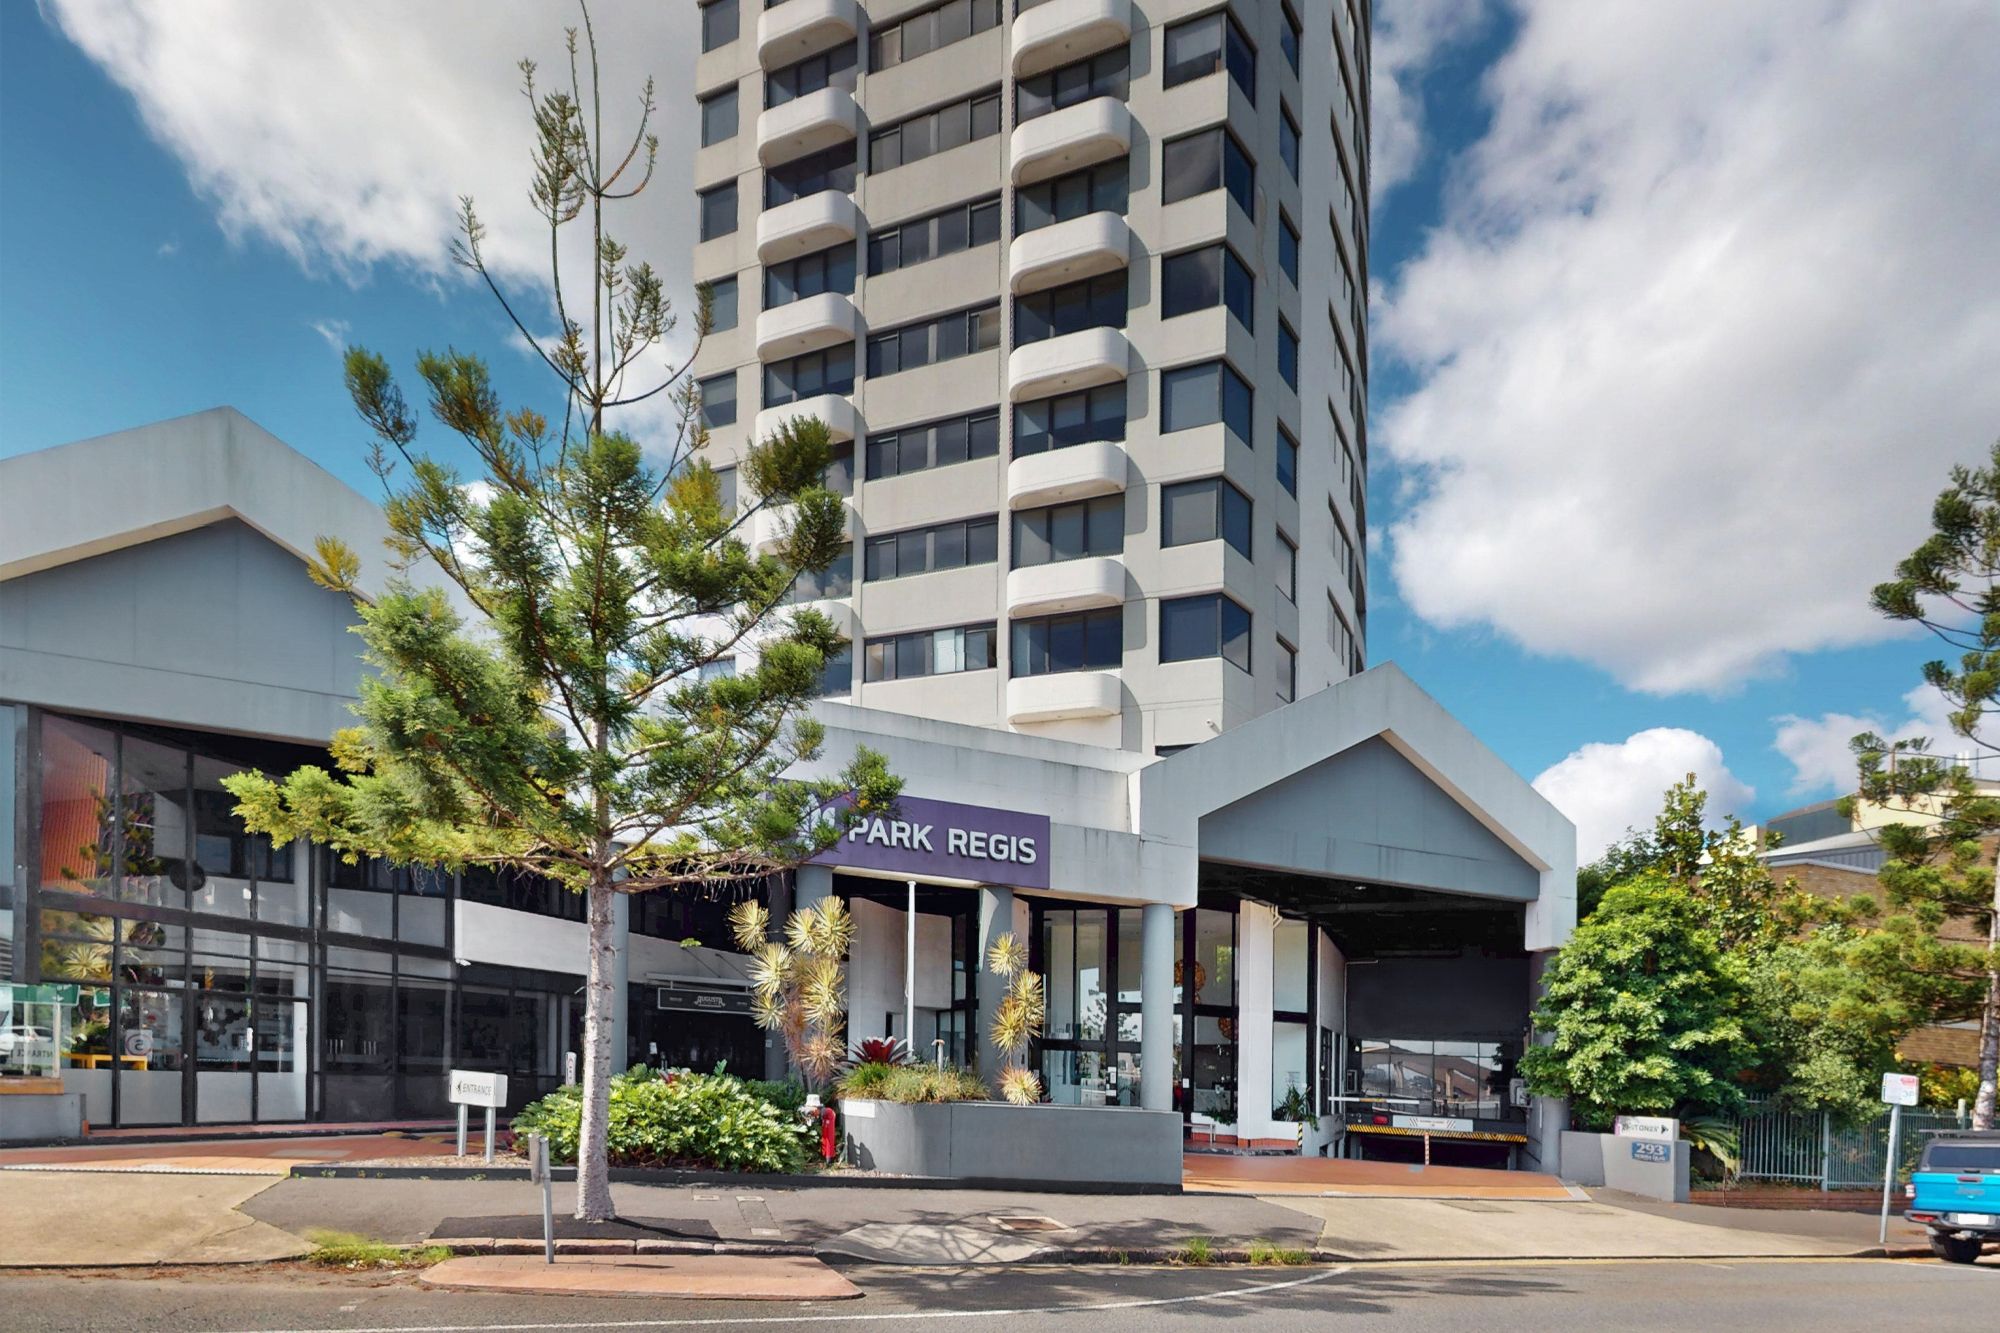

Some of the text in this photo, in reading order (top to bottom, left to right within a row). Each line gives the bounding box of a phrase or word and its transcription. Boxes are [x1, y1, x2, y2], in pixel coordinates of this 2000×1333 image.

[849, 814, 1037, 865] PARK REGIS
[462, 1083, 493, 1097] ENTRANCE
[1636, 1143, 1665, 1156] 293
